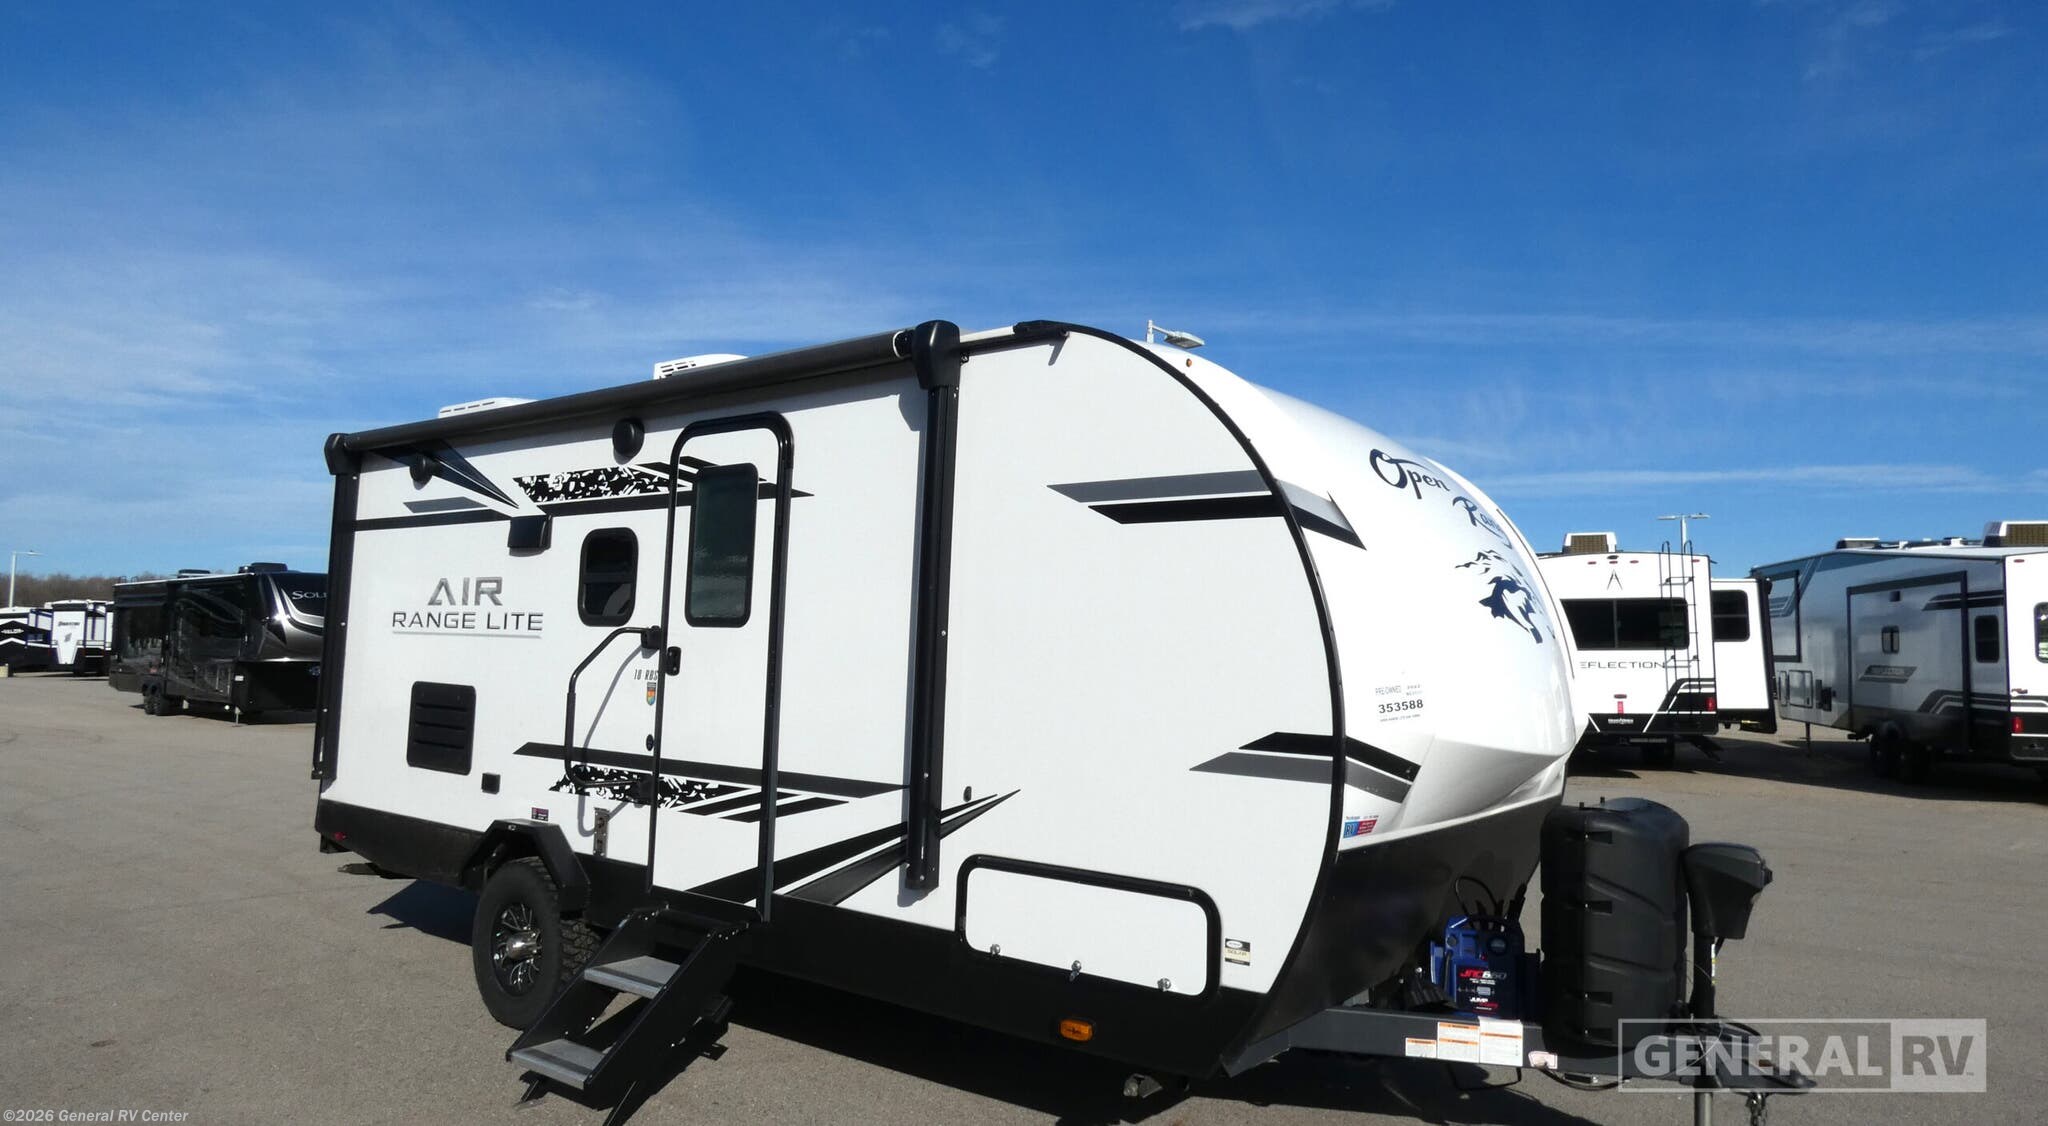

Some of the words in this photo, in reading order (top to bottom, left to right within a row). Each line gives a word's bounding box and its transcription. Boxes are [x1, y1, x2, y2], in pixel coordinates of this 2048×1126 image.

[1369, 448, 1451, 500] Open
[427, 576, 503, 606] AIR
[392, 611, 476, 630] RANGE
[486, 611, 544, 631] LITE
[1378, 698, 1424, 714] 353588
